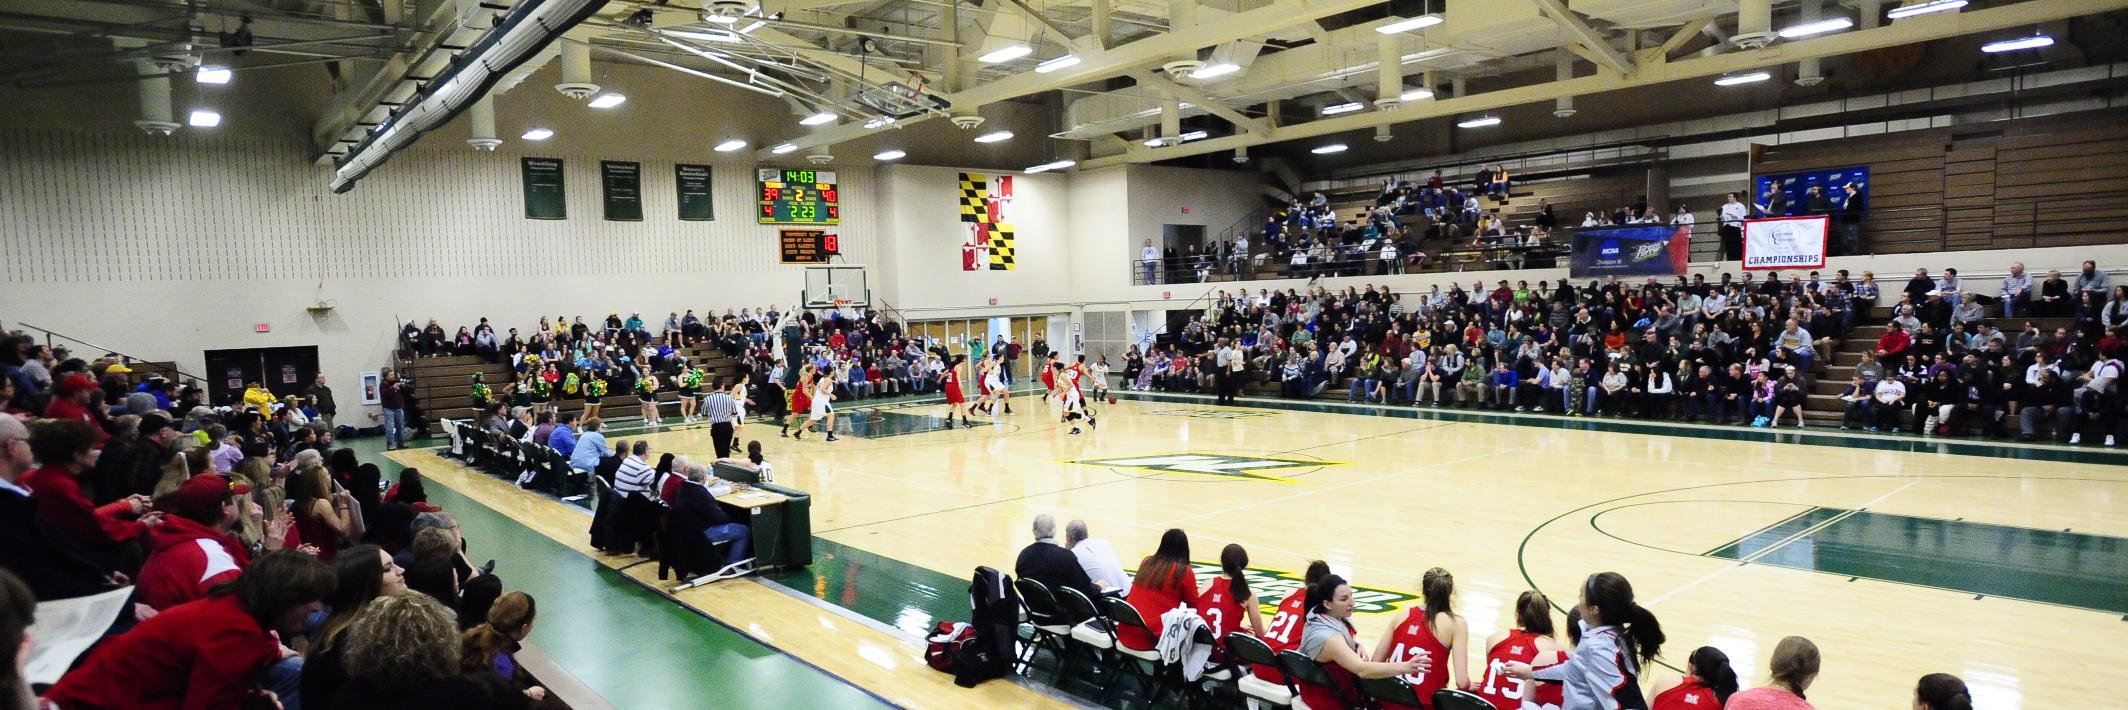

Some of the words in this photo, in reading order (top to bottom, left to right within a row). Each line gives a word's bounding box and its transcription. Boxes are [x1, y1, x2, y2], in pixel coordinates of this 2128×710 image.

[786, 171, 814, 183] 14:03
[764, 188, 779, 201] 39
[795, 189, 804, 202] 2
[821, 190, 836, 202] 40
[764, 205, 772, 216] 4
[790, 205, 798, 218] 2
[801, 205, 815, 218] 23
[829, 207, 837, 217] 4
[1602, 247, 1620, 255] NCAA
[1748, 254, 1819, 265] CHAMPIONSHIPS
[1206, 608, 1223, 640] 3
[1264, 611, 1299, 644] 21
[1484, 658, 1525, 699] 15
